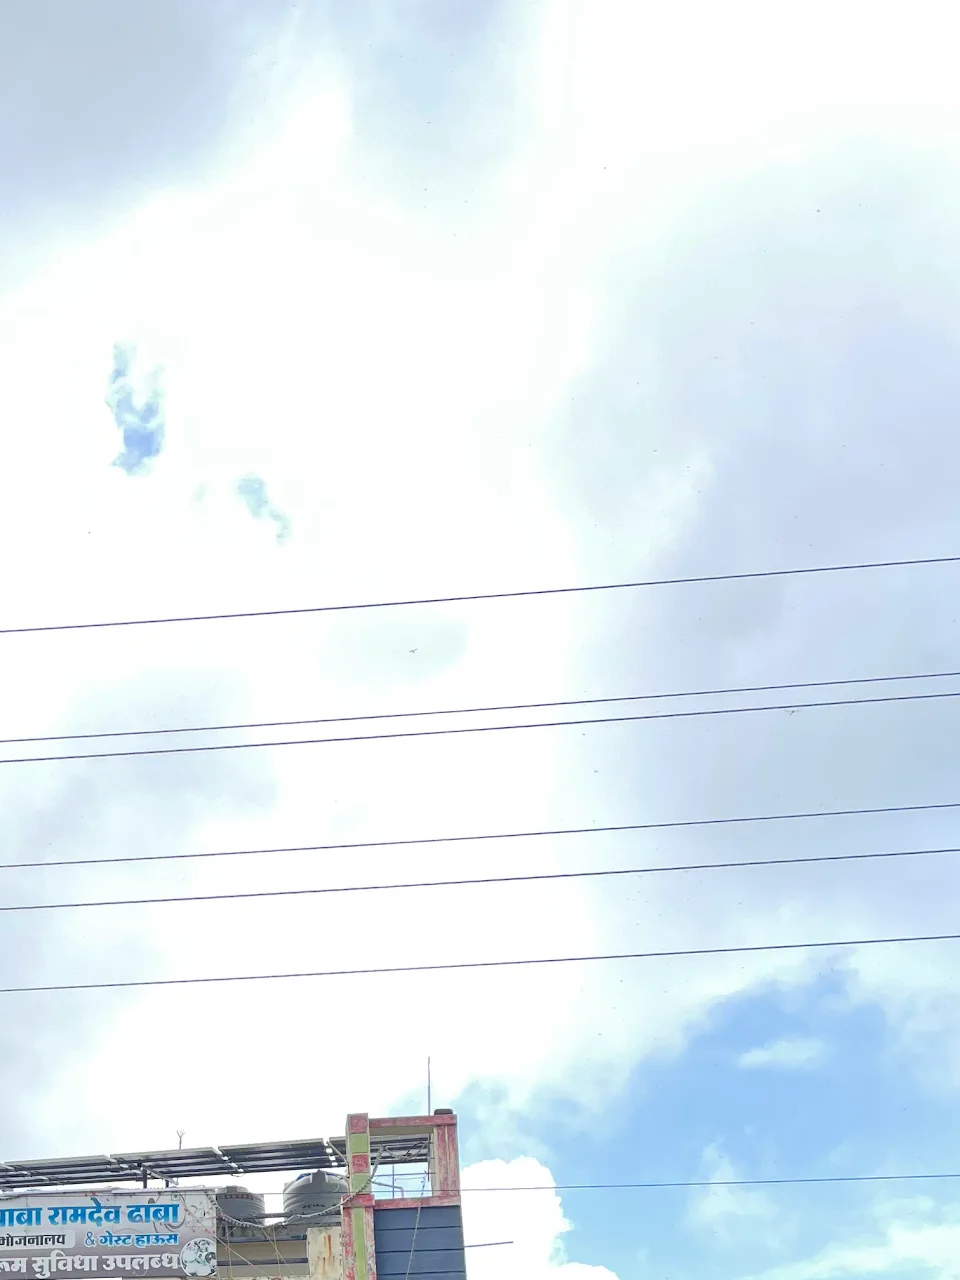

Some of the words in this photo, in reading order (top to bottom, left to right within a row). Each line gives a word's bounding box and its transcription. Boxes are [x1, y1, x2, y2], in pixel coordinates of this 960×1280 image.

[47, 1198, 121, 1228] रामदेव
[127, 1203, 180, 1225] ढाबा
[85, 1233, 96, 1246] &
[98, 1232, 133, 1248] गेस्ट
[135, 1232, 179, 1248] हाऊस
[31, 1251, 99, 1279] सुविधा
[102, 1253, 180, 1272] उपलब्ध
